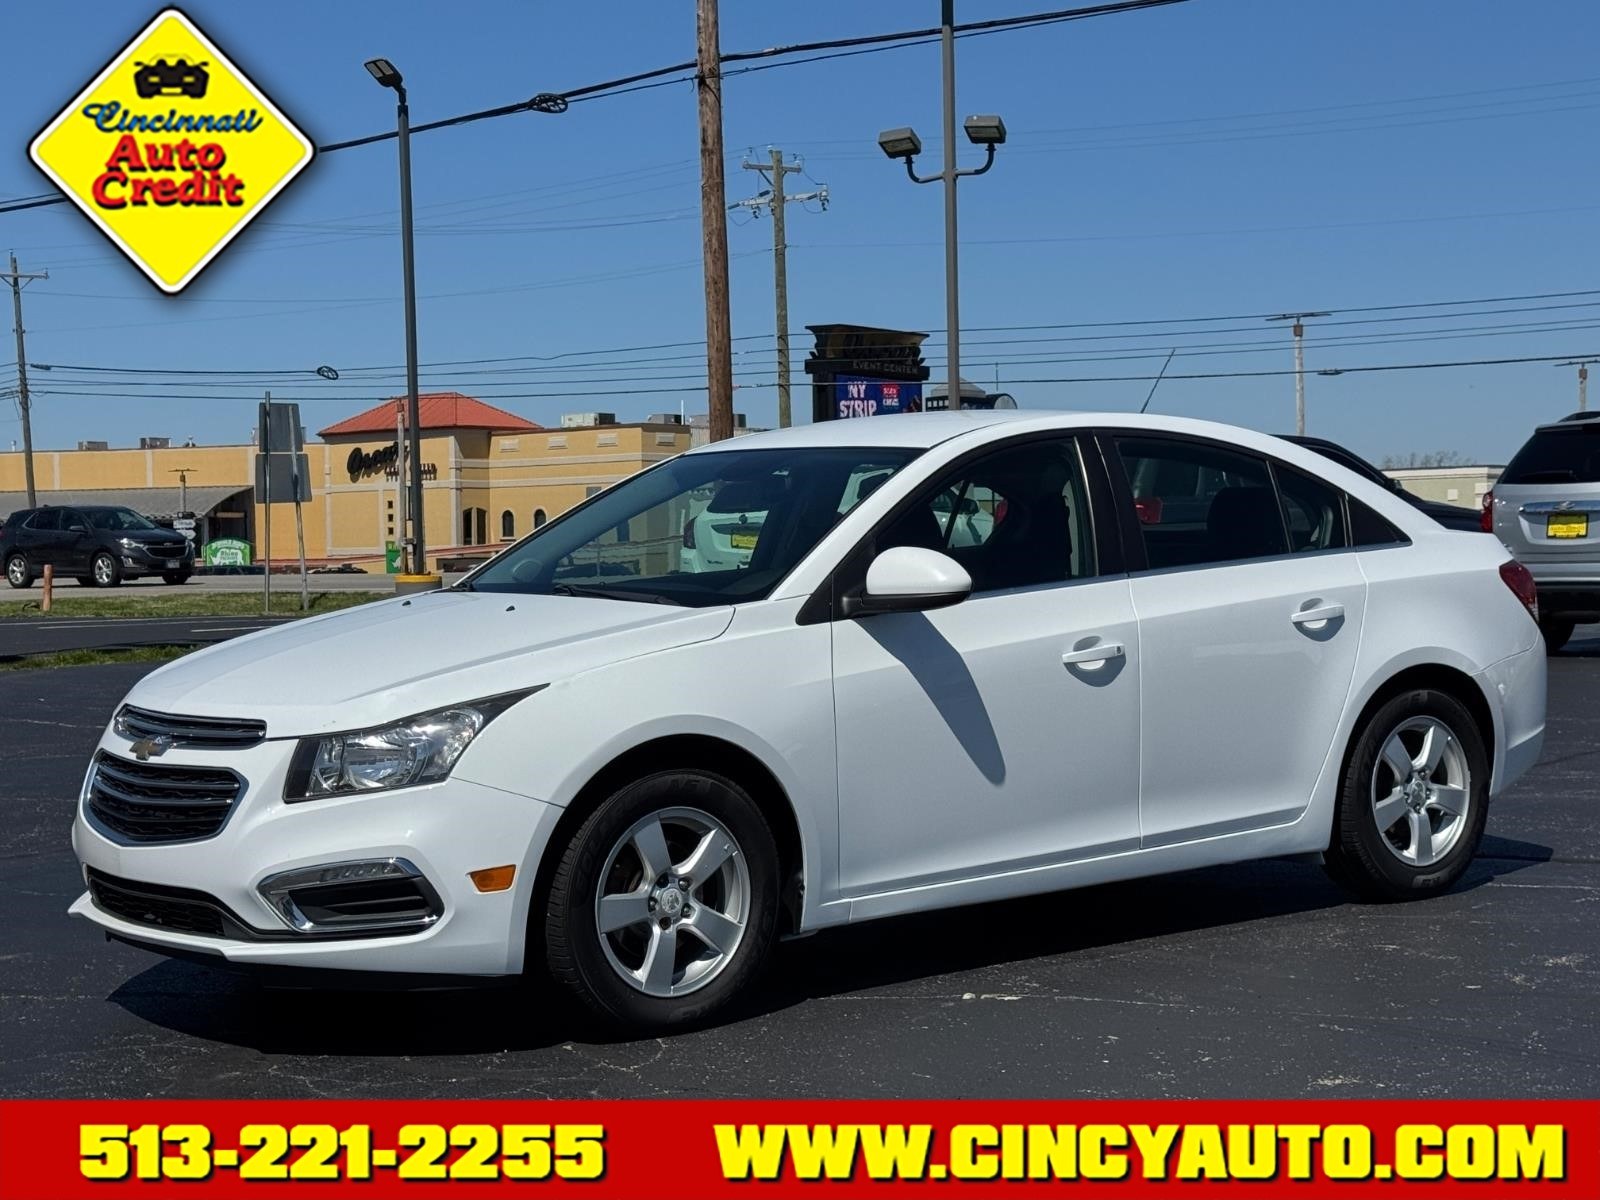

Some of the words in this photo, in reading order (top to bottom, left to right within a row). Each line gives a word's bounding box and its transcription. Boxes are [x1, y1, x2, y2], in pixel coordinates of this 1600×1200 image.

[852, 360, 881, 371] EVENT
[847, 381, 866, 398] NY
[840, 400, 877, 418] STRIP
